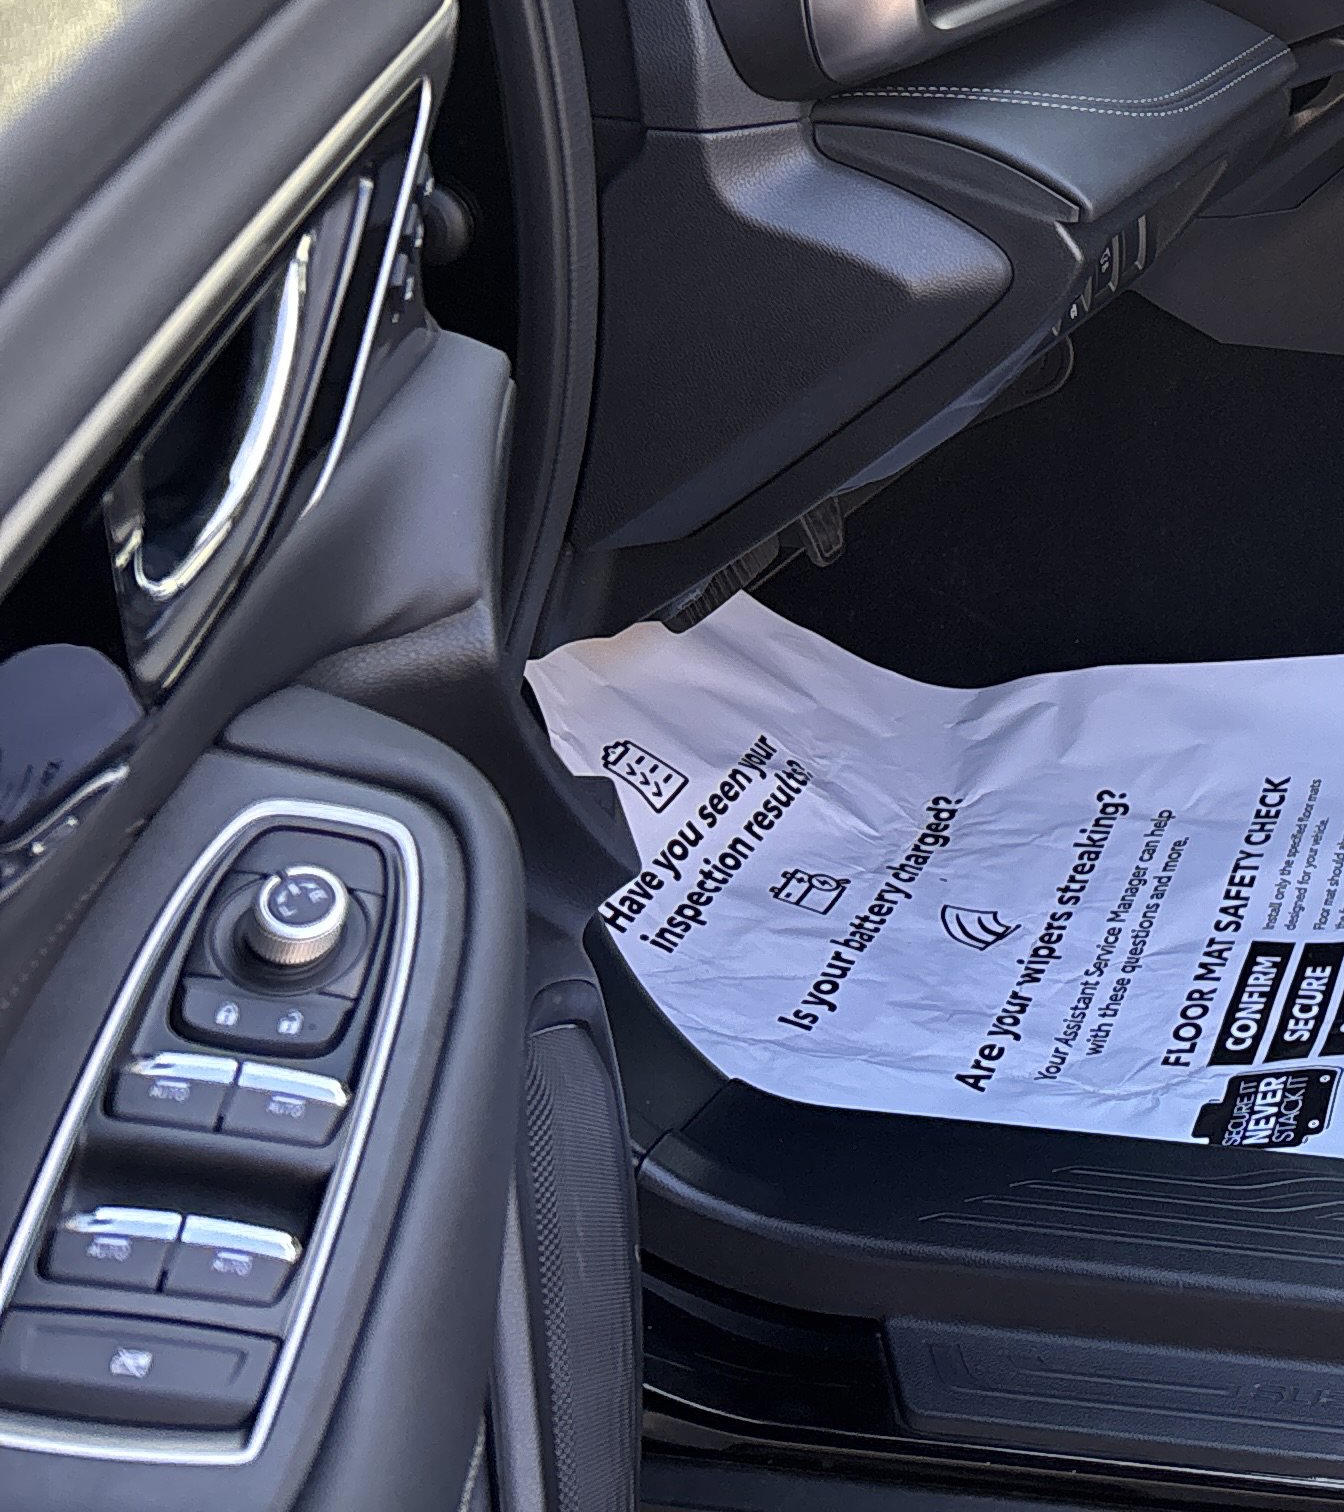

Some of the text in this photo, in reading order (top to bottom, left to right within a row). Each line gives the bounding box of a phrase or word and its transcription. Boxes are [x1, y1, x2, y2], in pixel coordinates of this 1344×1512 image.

[601, 735, 777, 933] Have you seen your
[641, 760, 813, 953] inspection results?
[777, 796, 963, 1031] Is your battery charged?
[1161, 777, 1291, 1067] FLOOR MAT SAFETY CHECK
[1274, 877, 1292, 901] only
[1283, 886, 1308, 931] designed
[1305, 847, 1319, 870] your
[955, 790, 1129, 1093] Are your wipers streaking?
[1034, 810, 1175, 1080] Your Assistant Service Manager can help
[1086, 837, 1189, 1055] with these questions and more.
[1226, 956, 1281, 1050] CONFIRM
[1284, 966, 1331, 1041] SECURE
[149, 1085, 190, 1102] AUTO
[266, 1101, 305, 1118] AUTO
[1222, 1081, 1257, 1146] SECURE IT
[1243, 1076, 1286, 1144] NEVER
[1272, 1076, 1308, 1141] STACK IT
[87, 1243, 131, 1262] AUTO
[211, 1259, 252, 1277] AUTO
